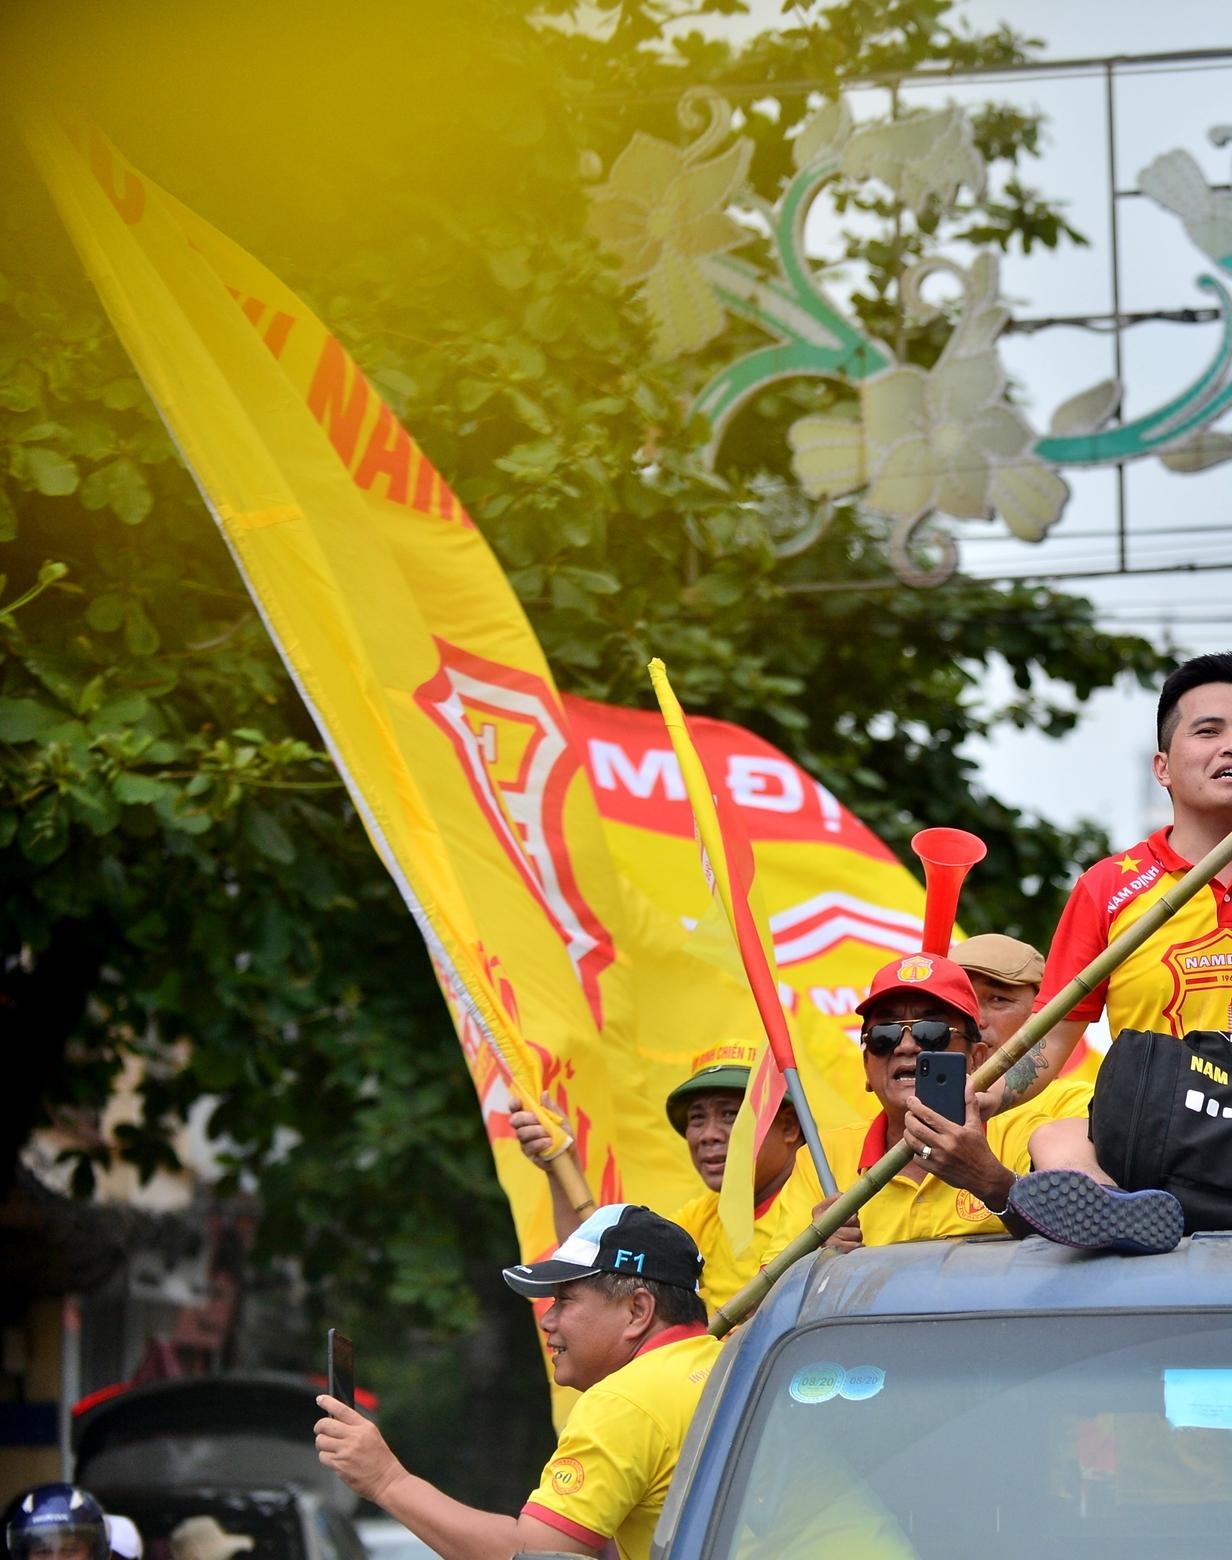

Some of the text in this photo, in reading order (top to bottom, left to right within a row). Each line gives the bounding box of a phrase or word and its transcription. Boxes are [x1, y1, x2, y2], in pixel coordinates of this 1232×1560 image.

[1107, 865, 1160, 914] NAM ĐỊNH
[1190, 1055, 1229, 1085] NAM
[614, 1249, 646, 1273] F1
